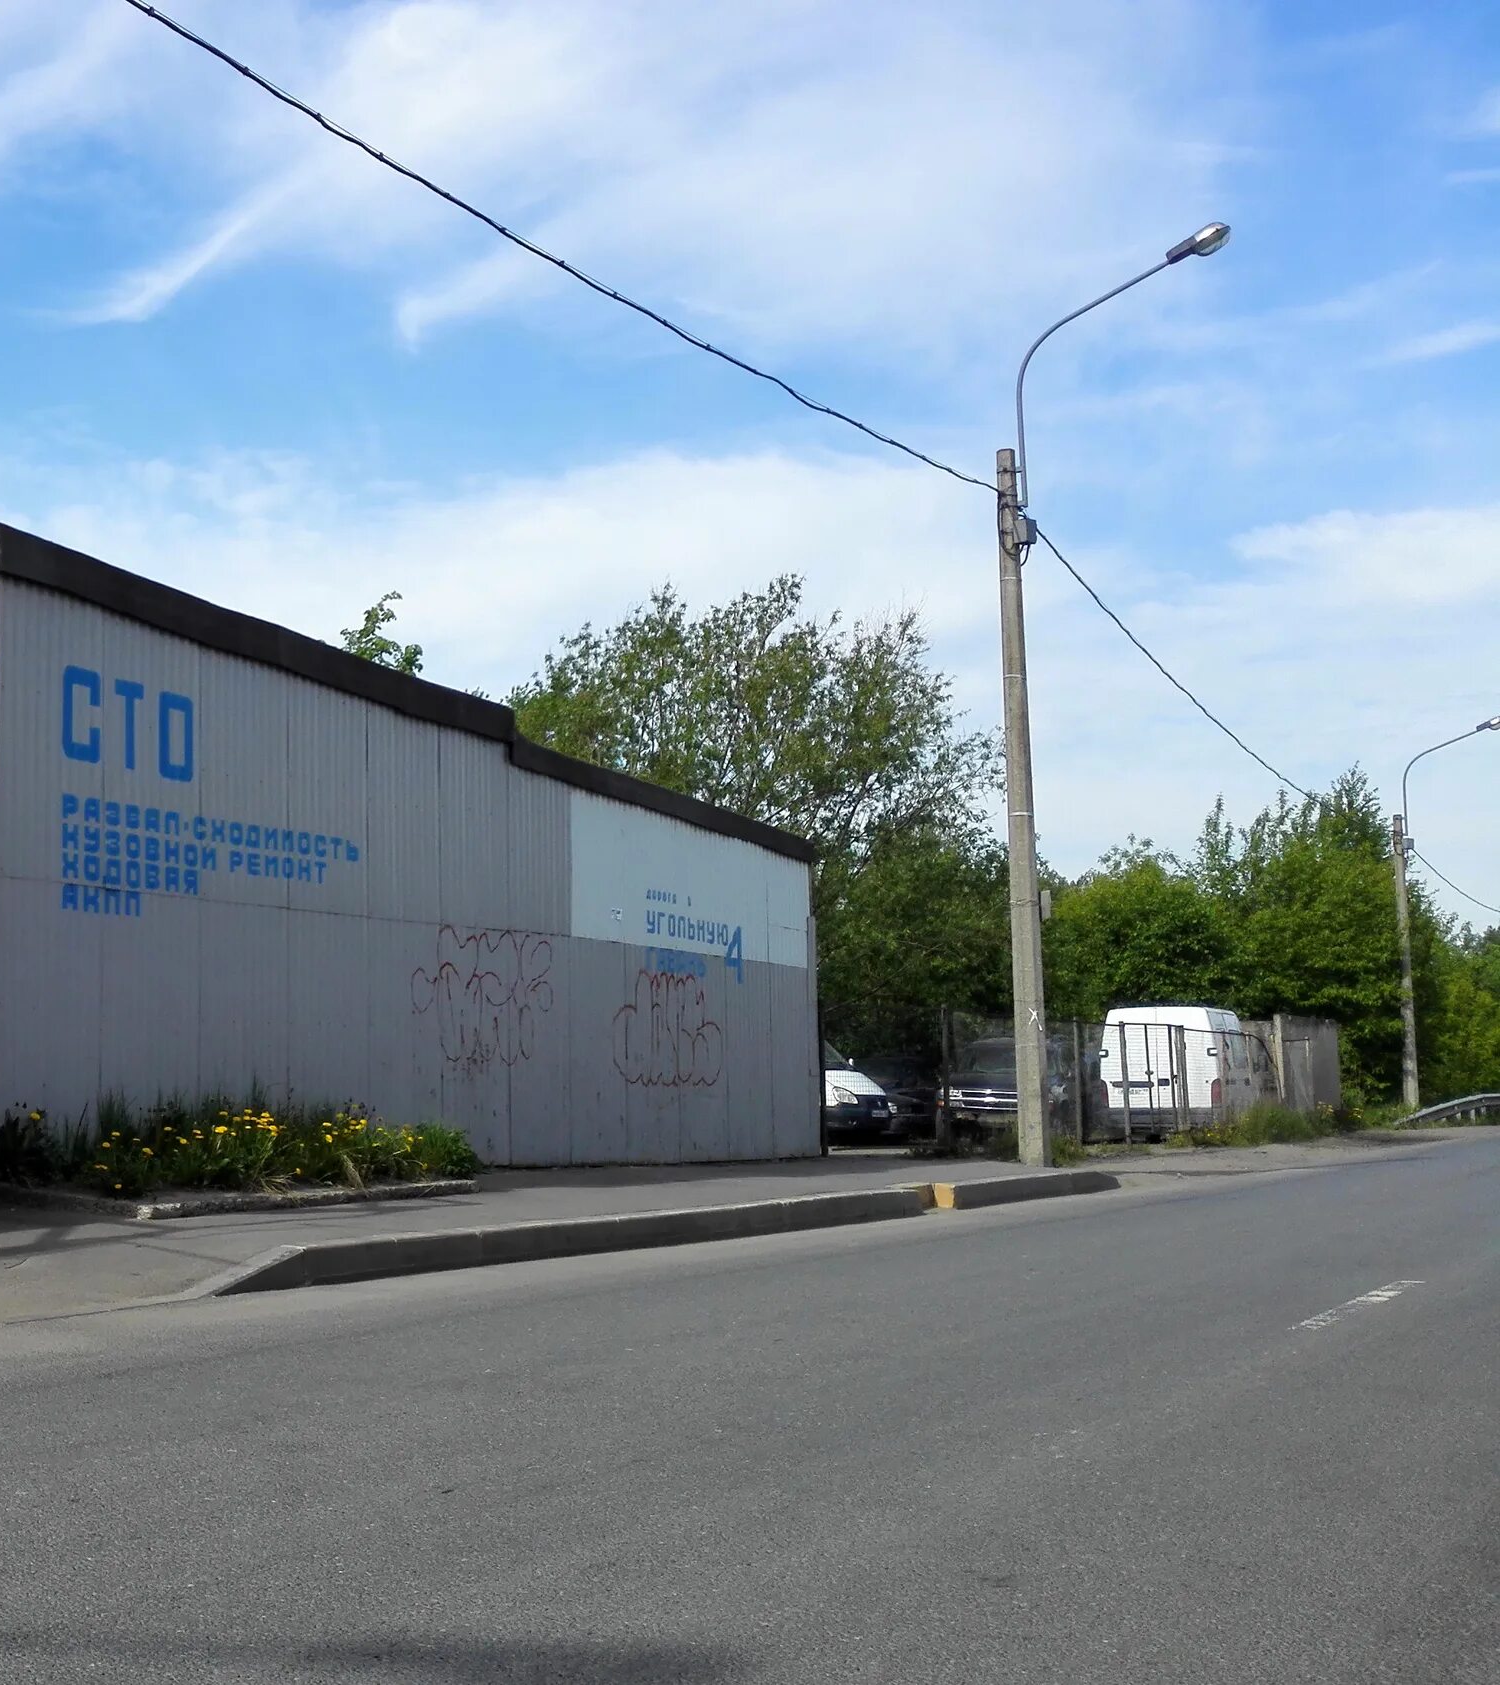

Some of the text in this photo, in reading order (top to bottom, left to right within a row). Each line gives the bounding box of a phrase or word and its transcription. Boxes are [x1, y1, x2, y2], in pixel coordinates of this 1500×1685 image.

[62, 664, 194, 783] СТО
[62, 822, 327, 885] КУЗОВНОЙ РЕМОНТ
[62, 852, 198, 896] ХОДОВАЯ
[61, 883, 141, 917] АКПП
[646, 910, 729, 947] УГОЛЬНУЮ
[725, 926, 744, 985] 4
